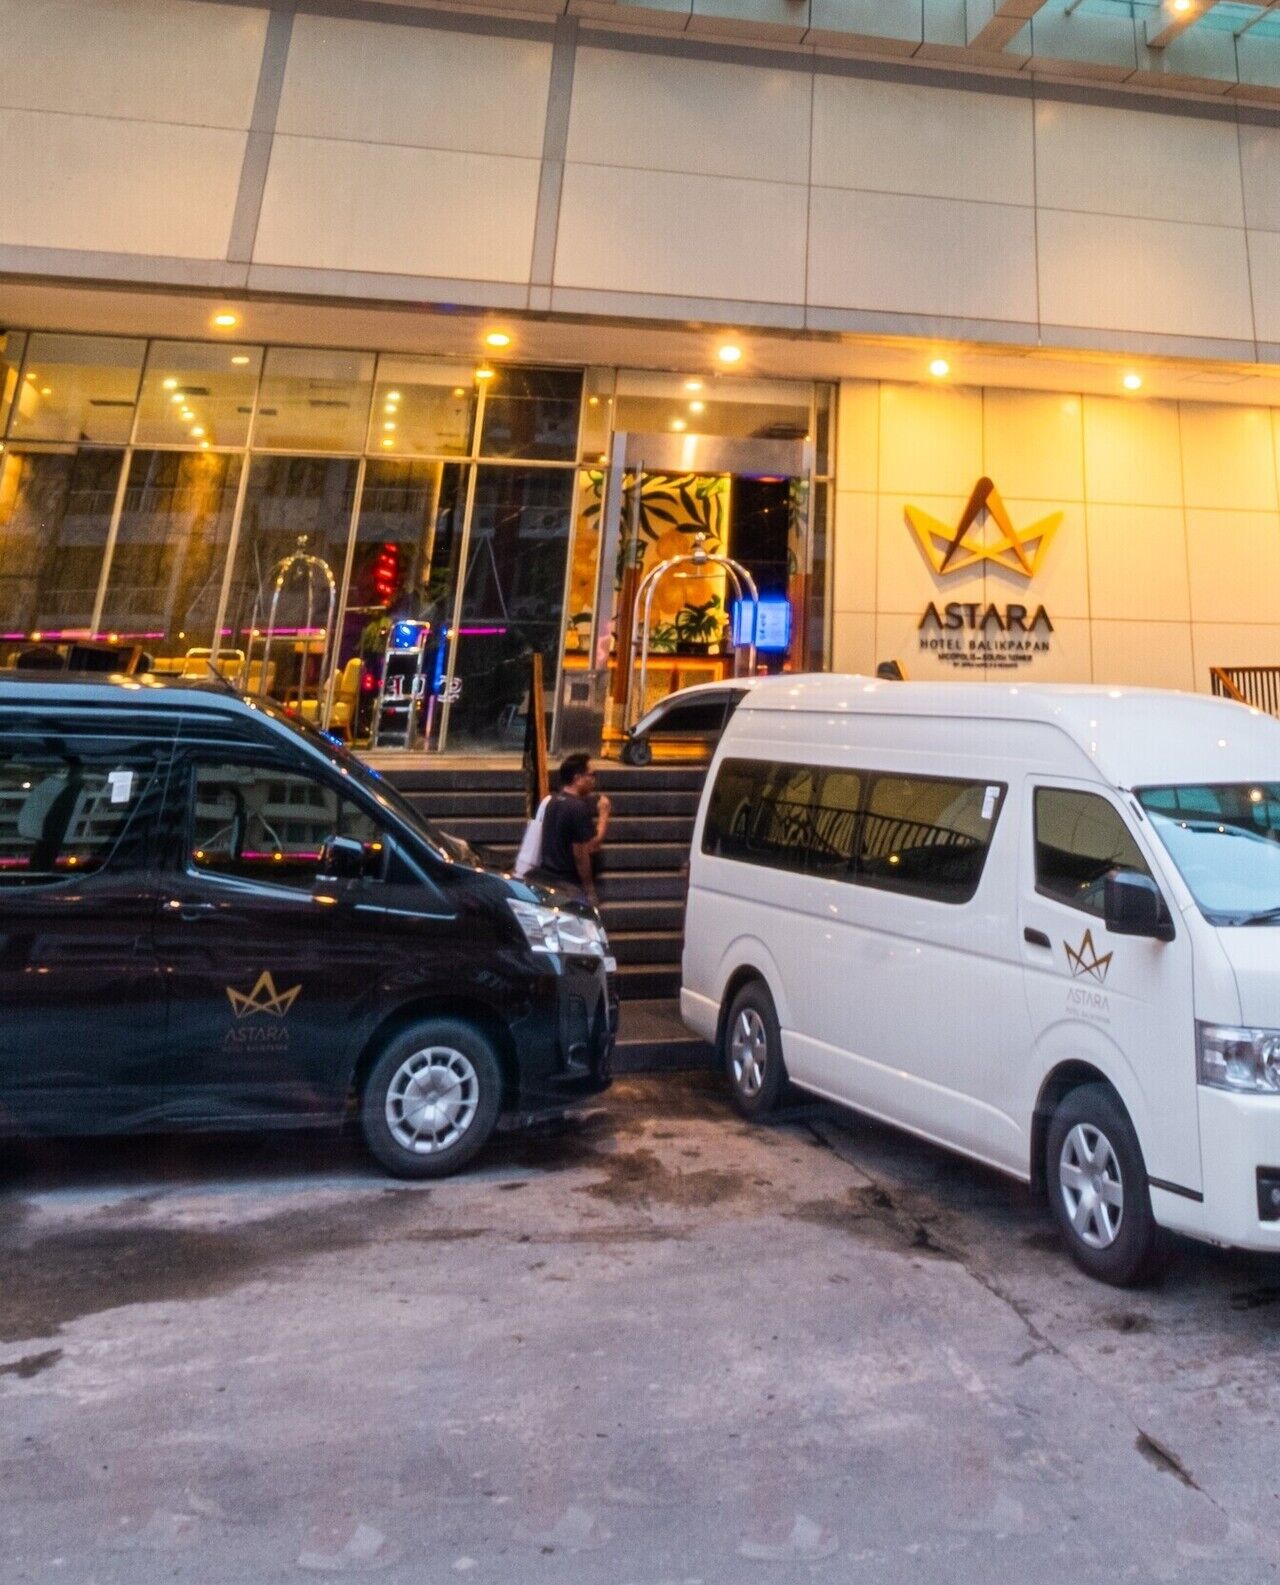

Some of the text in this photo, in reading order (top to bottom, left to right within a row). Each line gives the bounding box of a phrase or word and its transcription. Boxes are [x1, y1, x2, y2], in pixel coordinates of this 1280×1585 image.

[918, 601, 1054, 632] ASTARA
[920, 639, 1050, 651] HOTEL BALIKPAPAN
[224, 1026, 289, 1042] ASTARA
